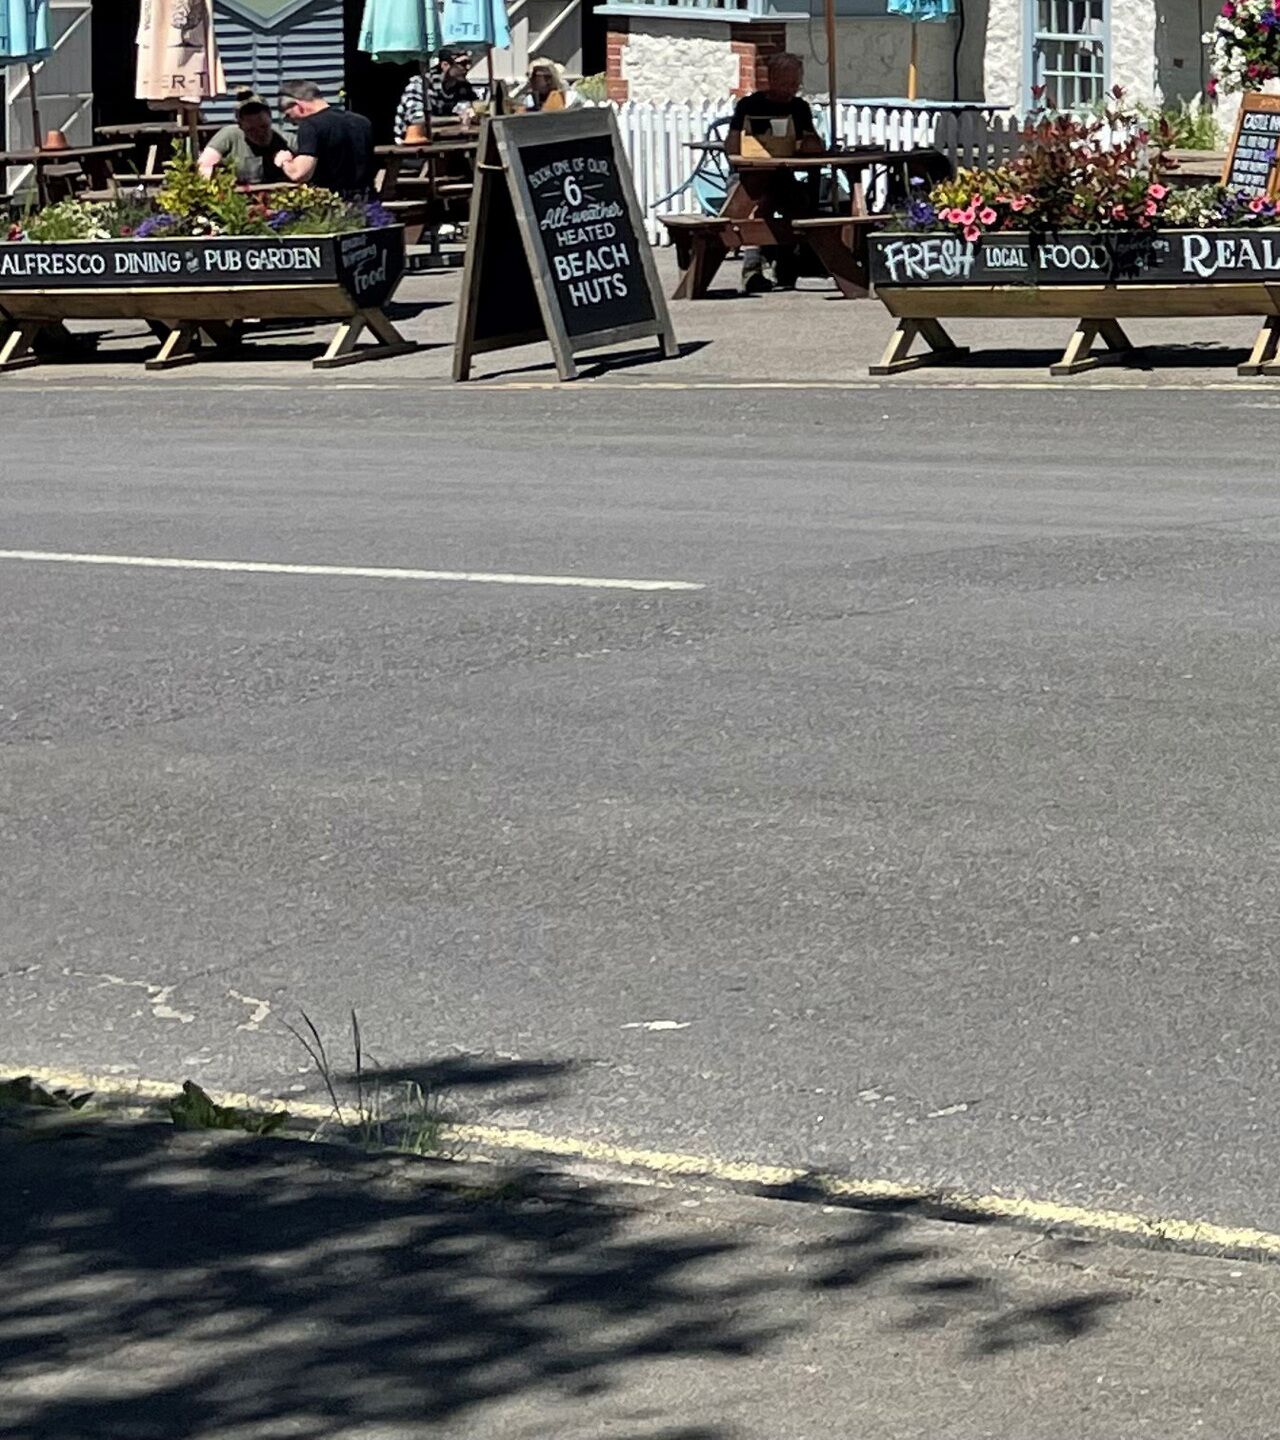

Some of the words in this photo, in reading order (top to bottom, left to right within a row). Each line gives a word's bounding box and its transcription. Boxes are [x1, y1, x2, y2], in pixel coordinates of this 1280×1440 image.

[528, 164, 555, 189] BOOK
[552, 159, 572, 176] ONE
[572, 157, 585, 172] OF
[587, 158, 611, 176] OUR
[563, 175, 583, 207] 6
[540, 201, 624, 231] All-weather
[555, 222, 617, 248] HEATED
[0, 252, 106, 276] ALFRESCO
[114, 250, 182, 274] DINING
[203, 248, 242, 271] PUB
[245, 246, 321, 271] GARDEN
[353, 248, 388, 295] Food
[553, 243, 631, 282] BEACH
[986, 247, 1029, 269] LOCAL
[567, 273, 628, 307] HUTS
